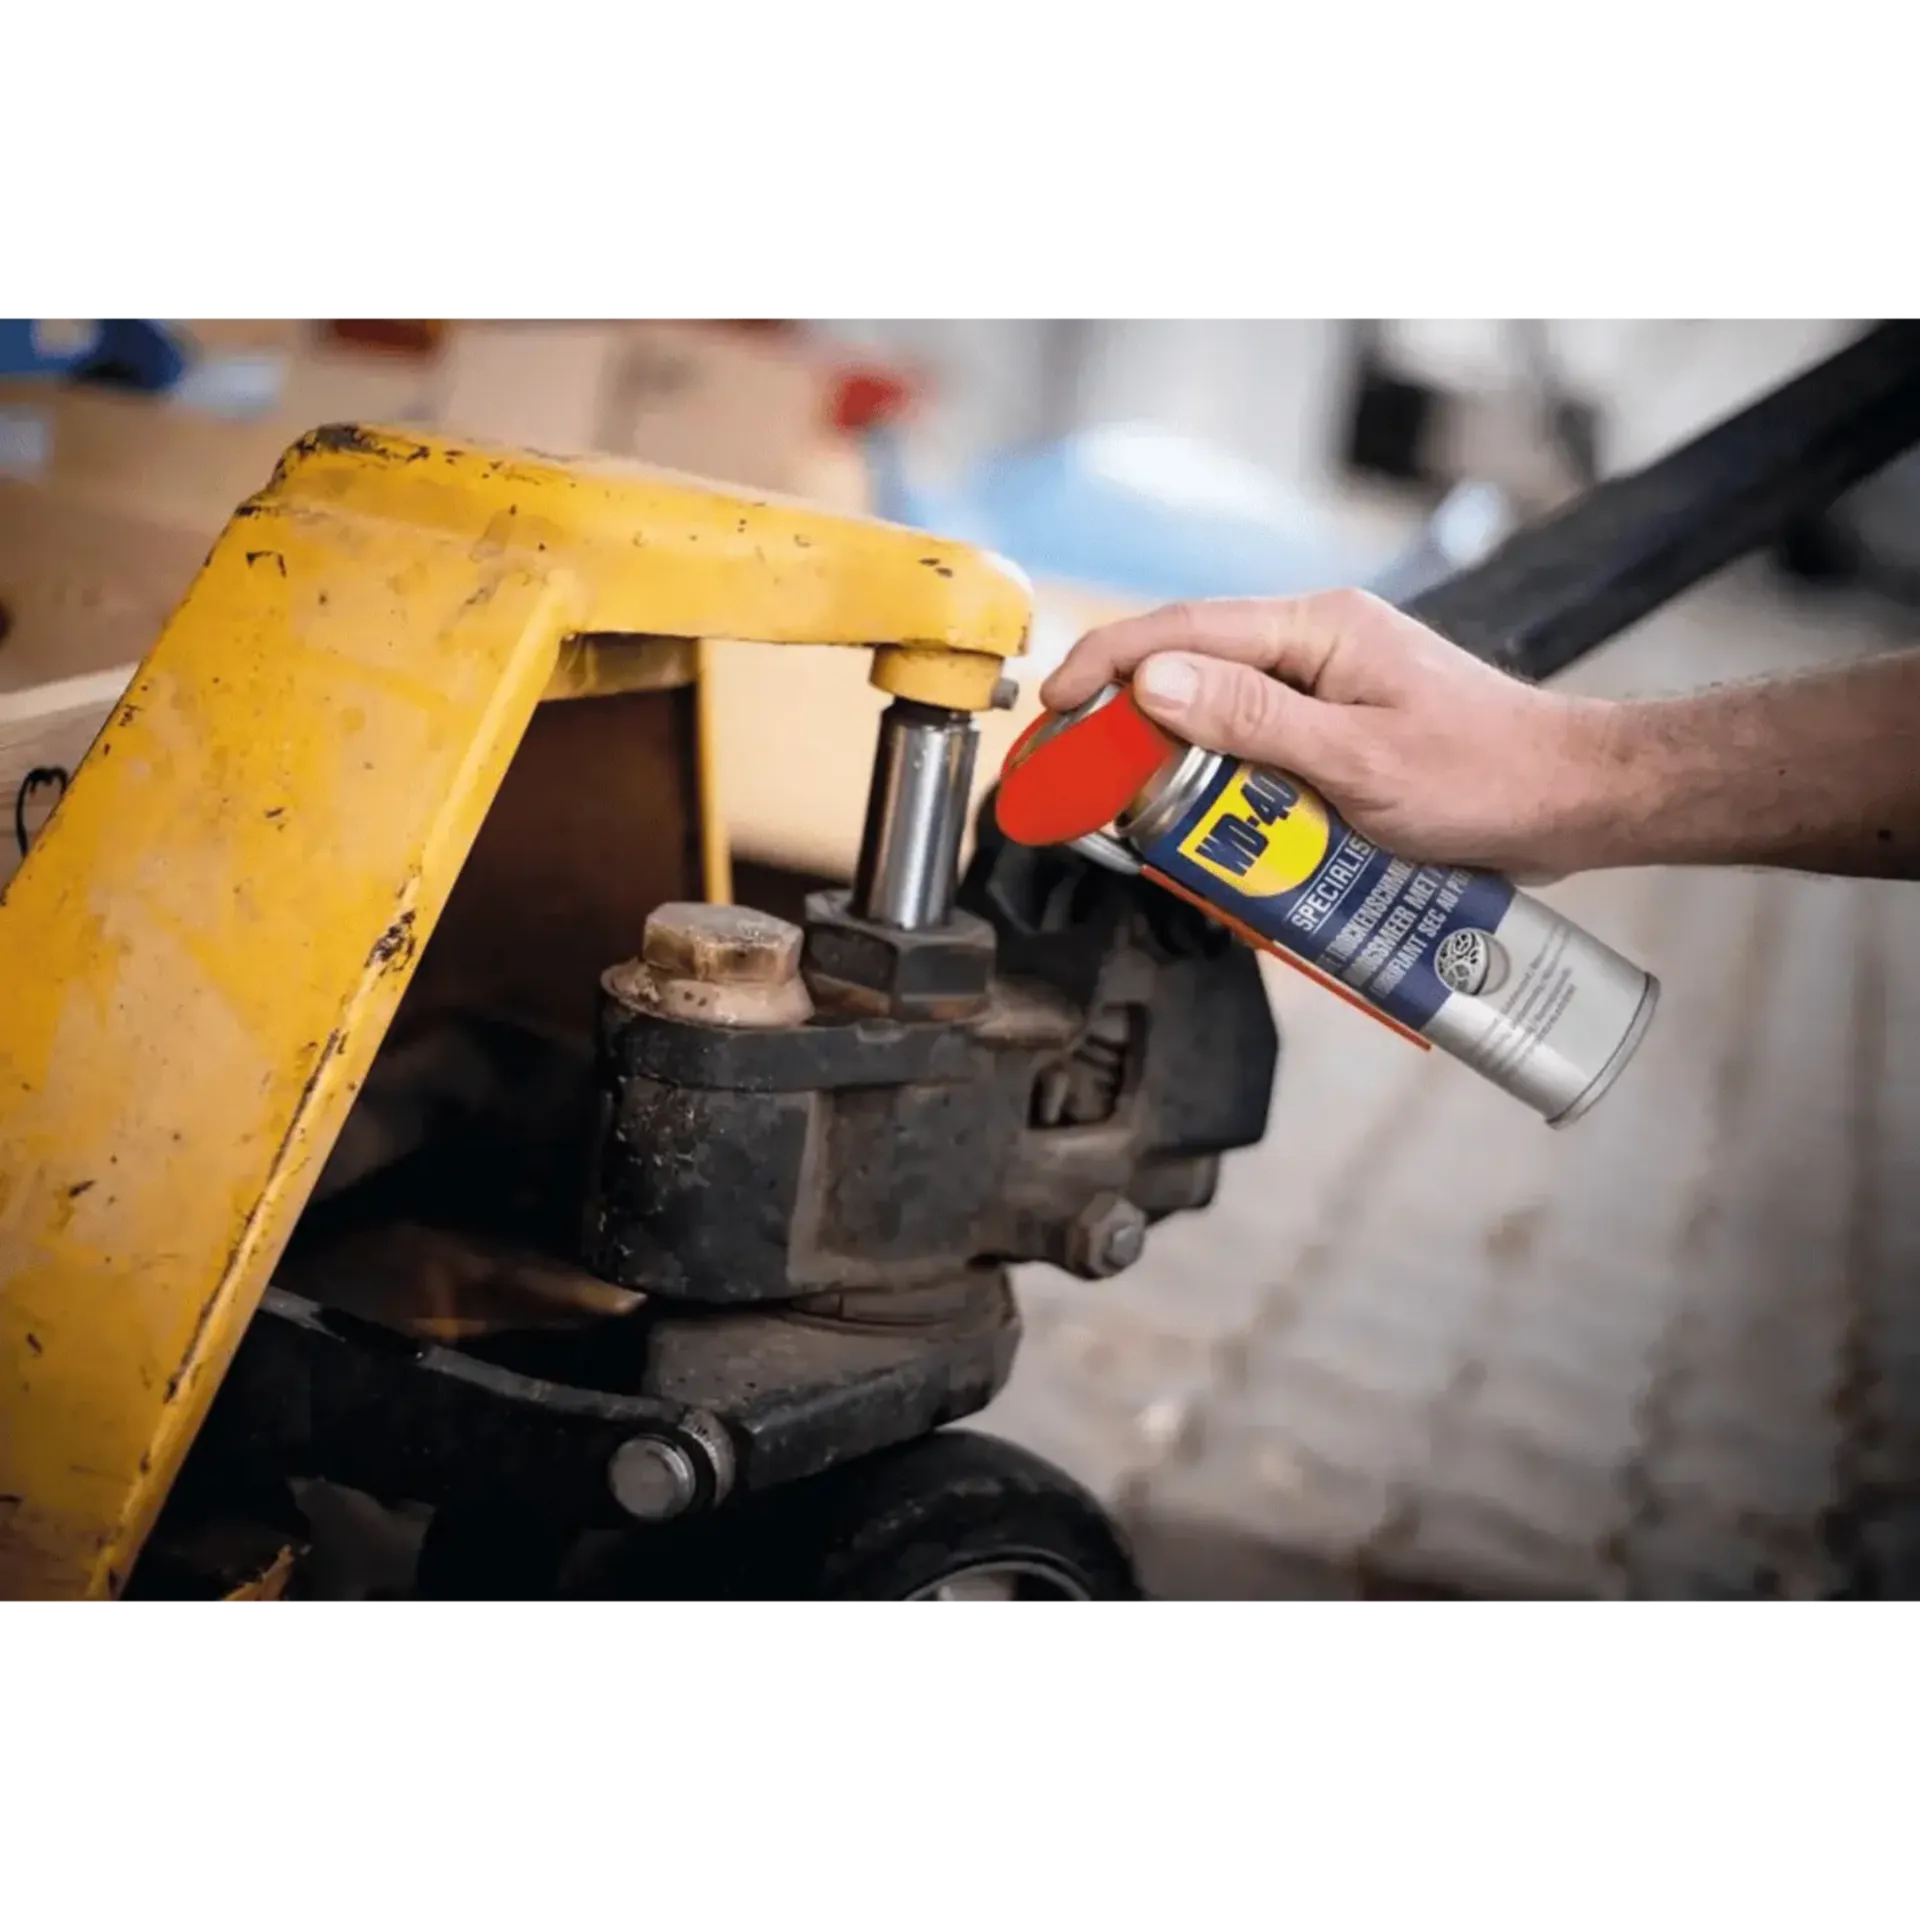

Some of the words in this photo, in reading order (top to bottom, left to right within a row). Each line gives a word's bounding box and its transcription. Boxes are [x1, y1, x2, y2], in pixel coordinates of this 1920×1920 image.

[1194, 767, 1298, 877] WD-40
[1290, 834, 1374, 932] SPECIALIS
[1403, 872, 1438, 911] MET
[1416, 907, 1447, 939] SEC
[1435, 887, 1459, 912] AU
